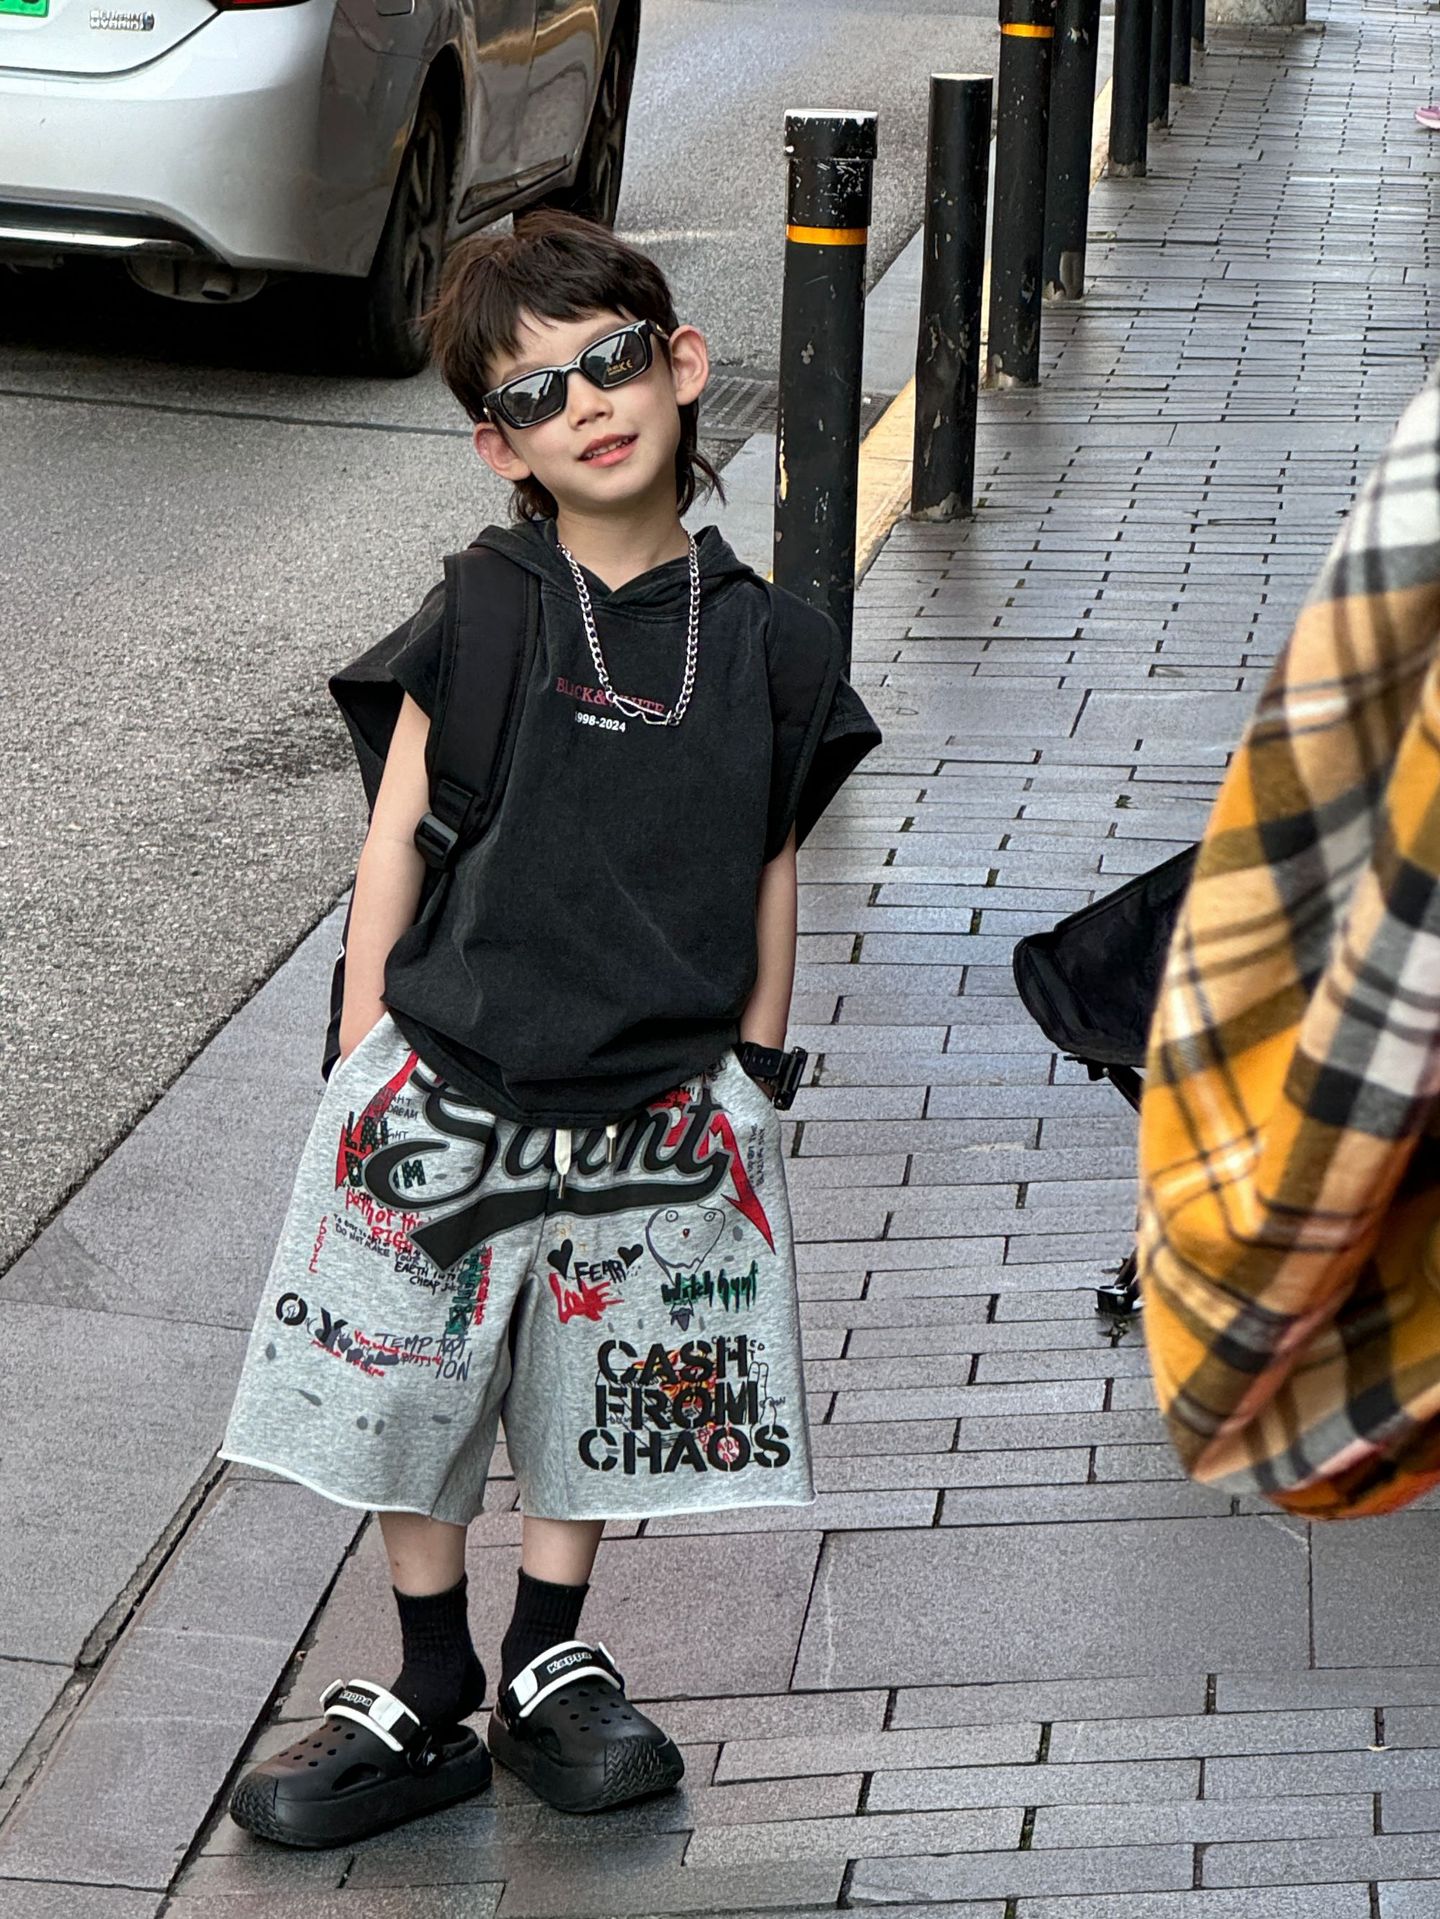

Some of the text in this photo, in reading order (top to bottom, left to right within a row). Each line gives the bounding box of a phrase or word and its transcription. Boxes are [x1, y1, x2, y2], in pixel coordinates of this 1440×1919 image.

[573, 1259, 627, 1292] FEAR
[597, 1334, 749, 1386] CASH
[595, 1380, 758, 1431] FROM
[578, 1424, 791, 1475] CHAOS
